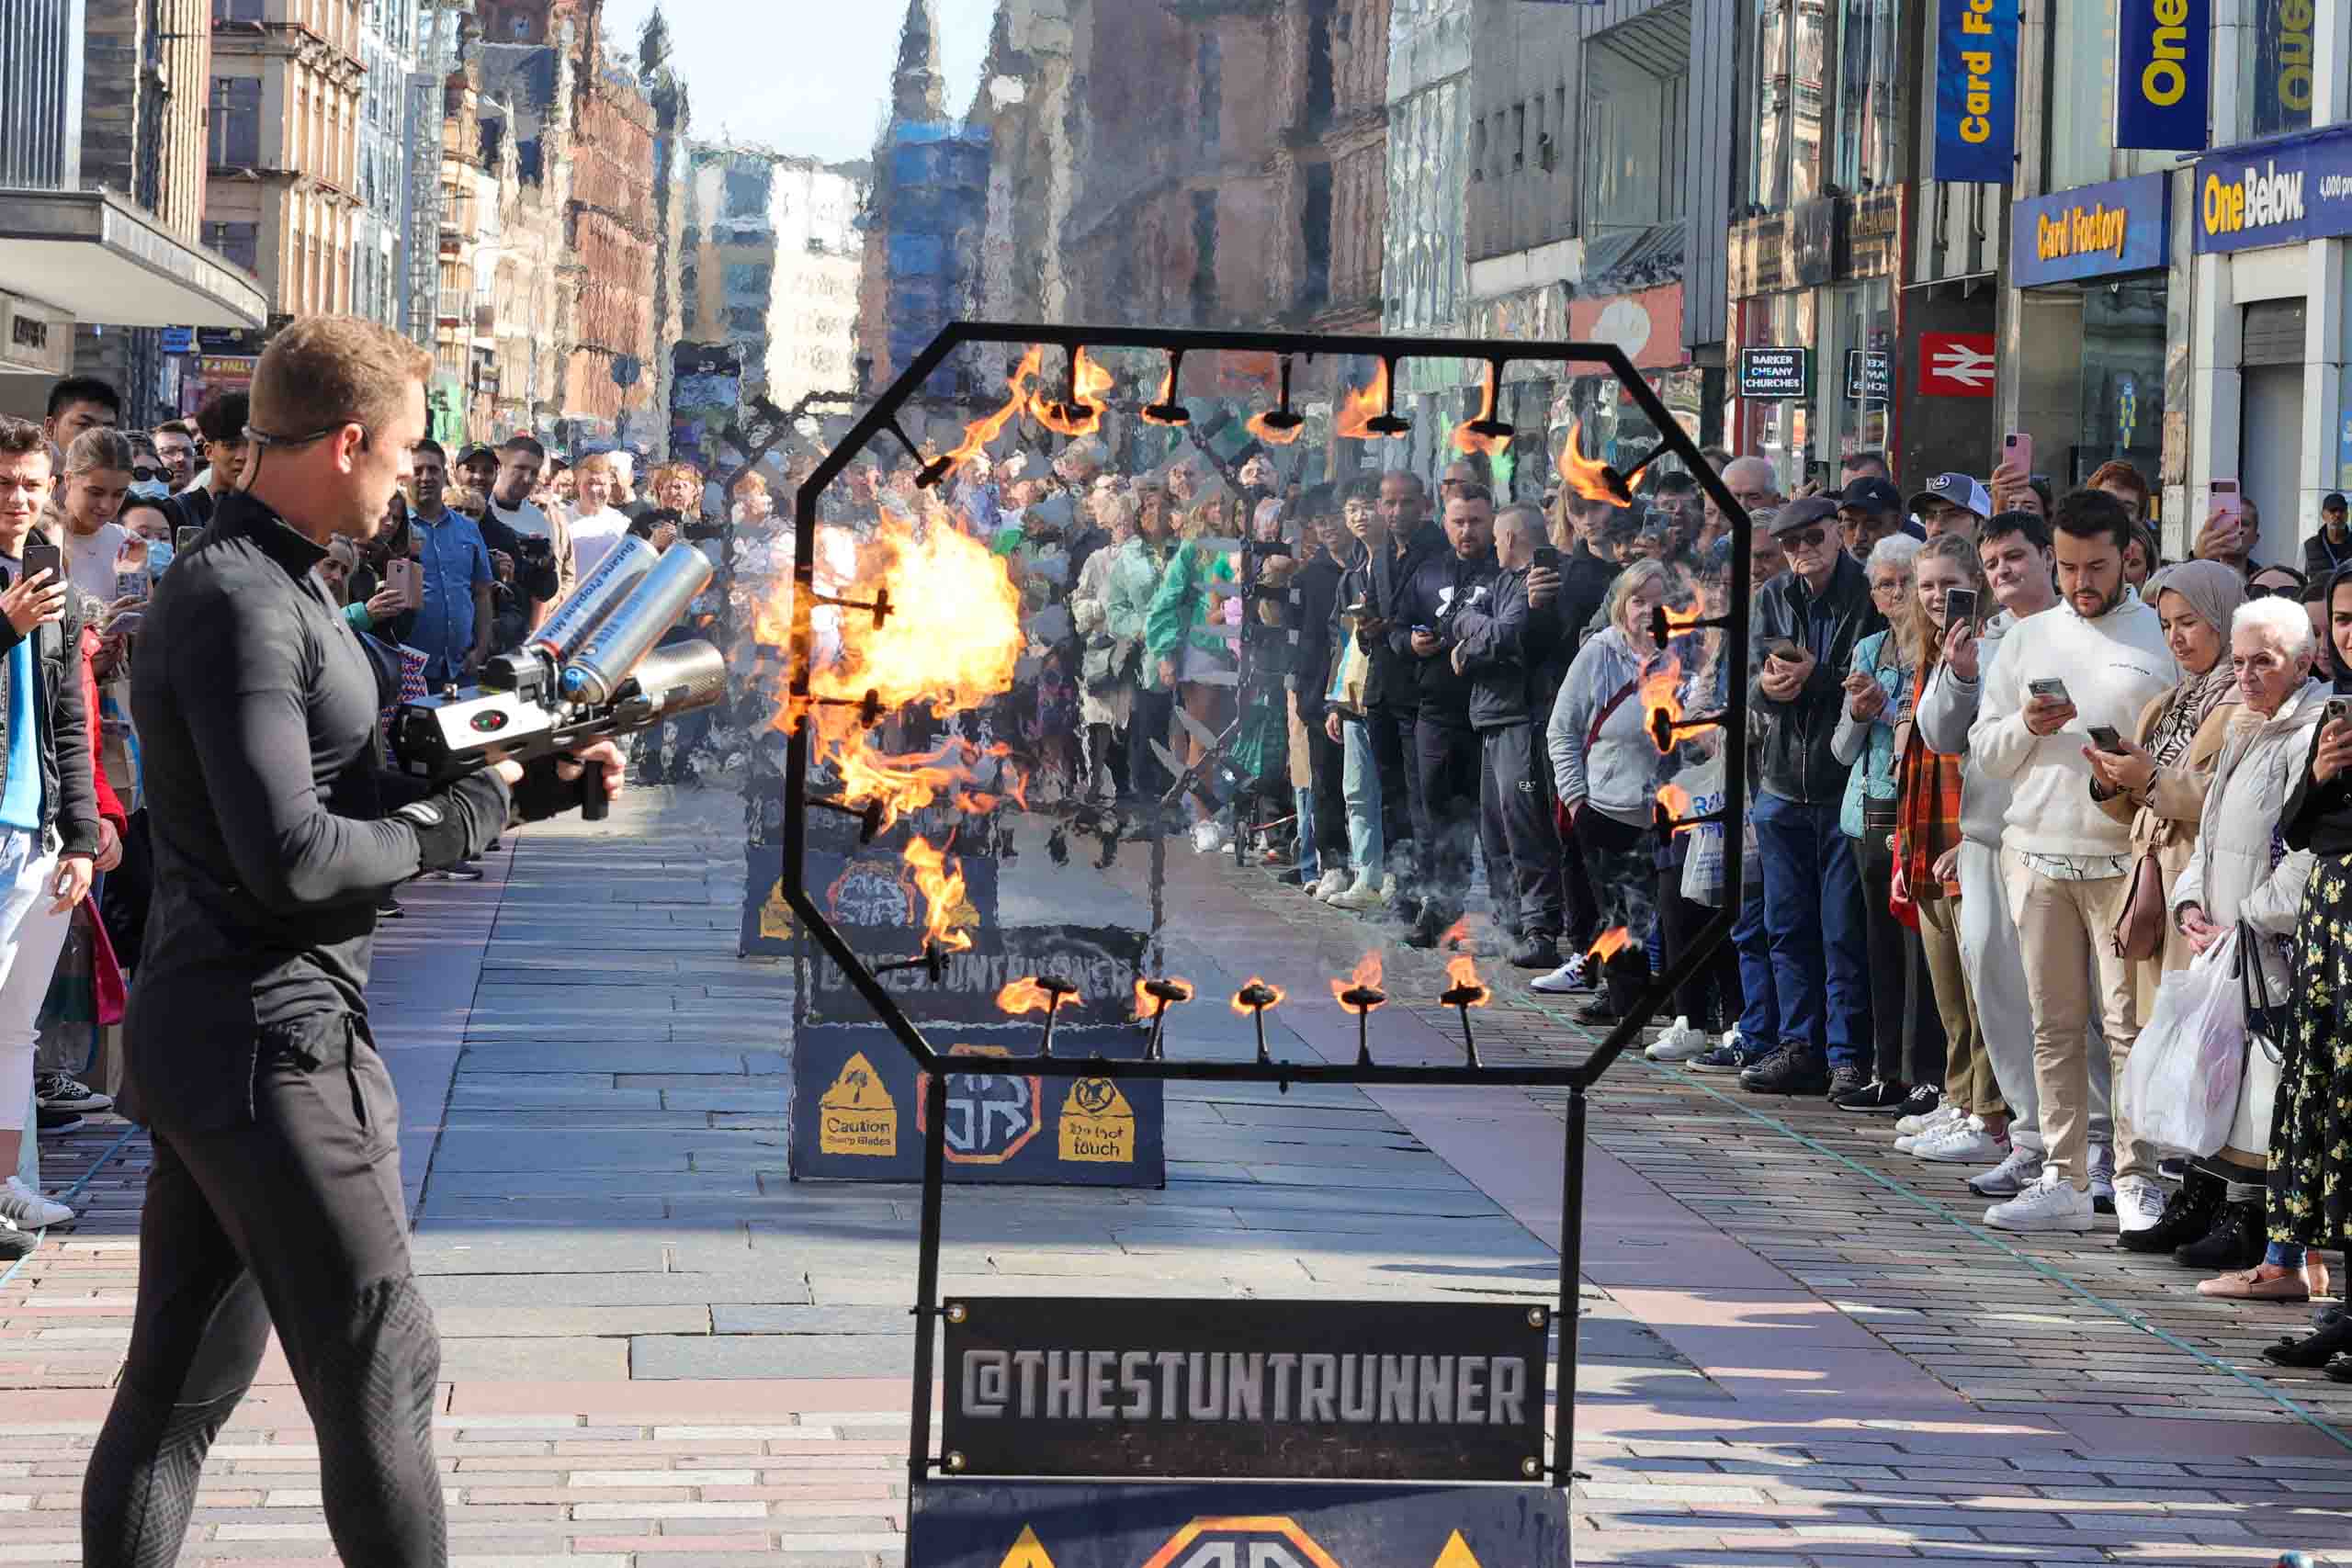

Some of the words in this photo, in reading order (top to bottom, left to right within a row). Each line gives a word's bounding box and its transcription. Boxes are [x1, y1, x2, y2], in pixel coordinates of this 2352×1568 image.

[2142, 0, 2188, 107] One
[1960, 51, 1992, 144] Card
[2038, 209, 2070, 261] Card
[2073, 202, 2126, 259] Factory
[1751, 367, 1793, 376] CHEANY
[1752, 355, 1793, 365] BARKER
[1746, 378, 1800, 388] CHURCHES
[601, 540, 637, 579] Butane
[827, 1117, 890, 1133] Caution
[1073, 1140, 1120, 1156] touch
[961, 1348, 1527, 1425] @THESTUNTRUNNER
